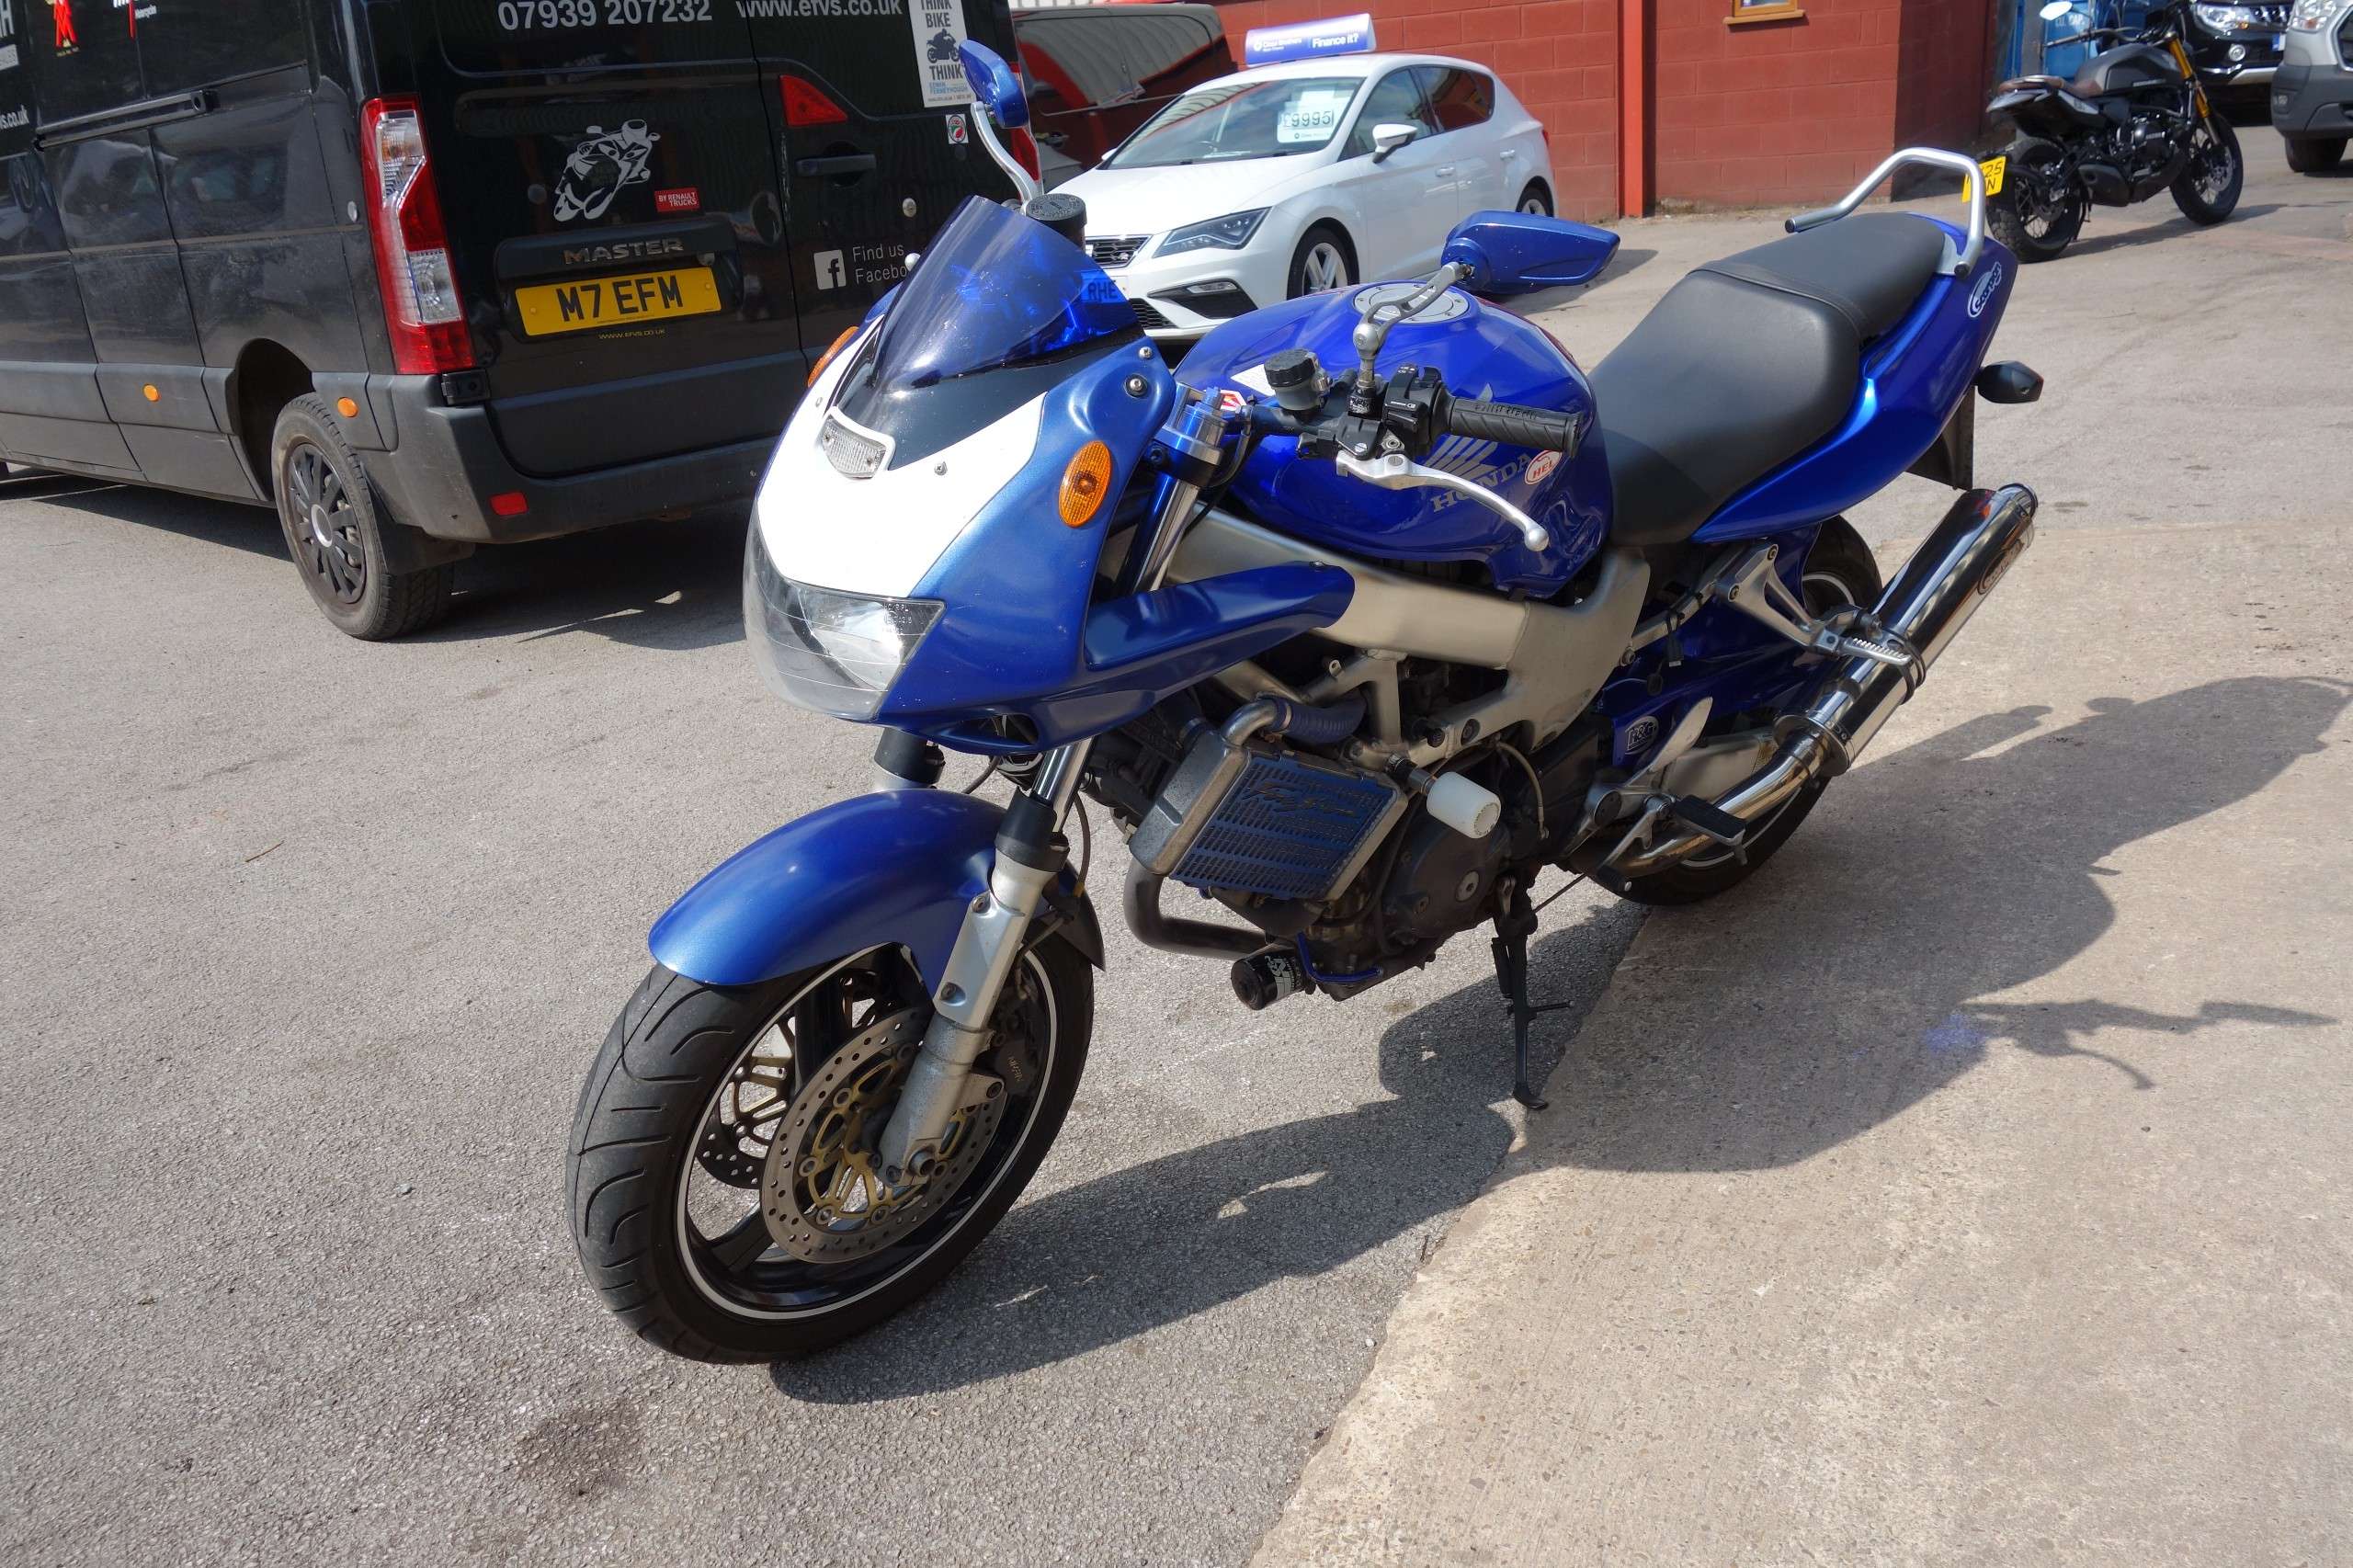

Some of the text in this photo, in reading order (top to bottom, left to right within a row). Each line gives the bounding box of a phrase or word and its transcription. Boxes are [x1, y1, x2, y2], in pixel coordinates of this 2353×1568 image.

[497, 0, 713, 29] 07939 207232
[921, 0, 952, 10] THINK
[926, 13, 951, 28] BIKE
[929, 63, 963, 80] THINK
[658, 191, 697, 202] BY RENAULT
[669, 199, 698, 208] TRUCKS
[563, 237, 684, 265] MASTER
[852, 244, 904, 263] Find us
[855, 265, 907, 284] Facebo
[555, 275, 684, 322] M7 EFM
[1532, 460, 1554, 479] HEL
